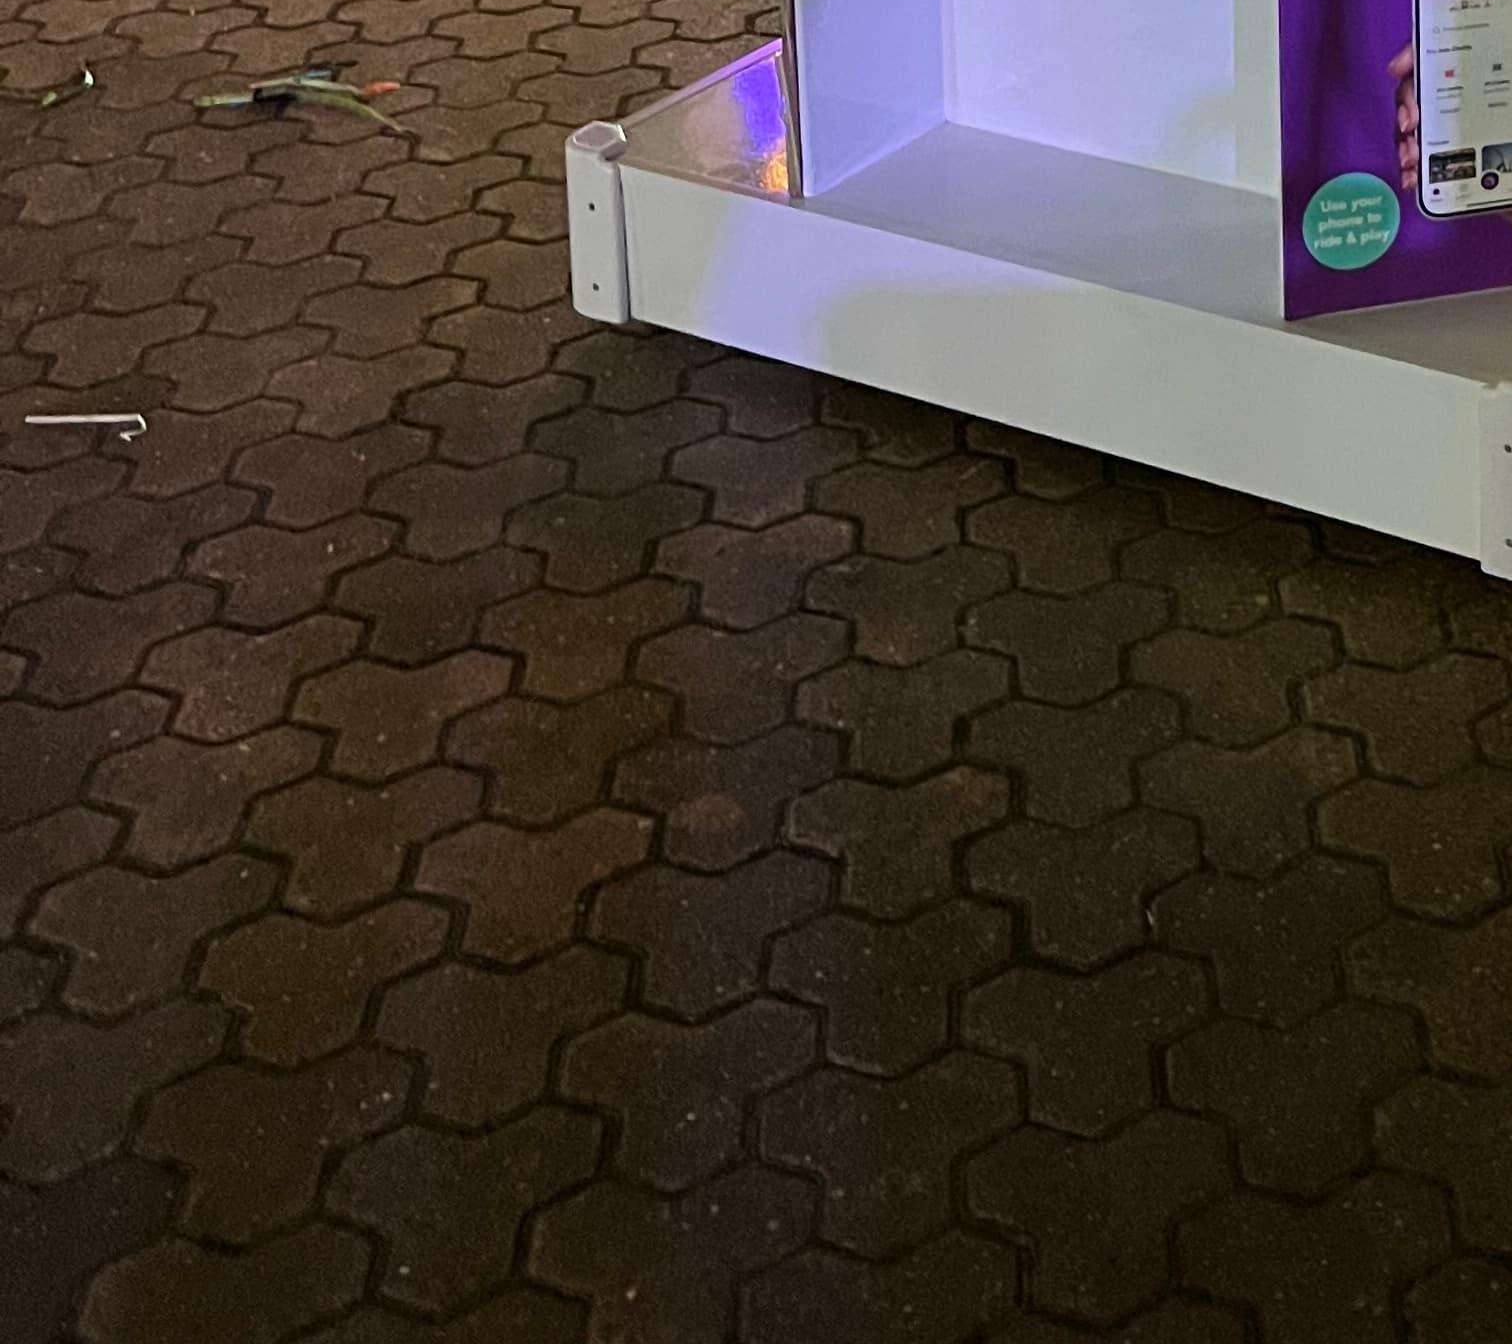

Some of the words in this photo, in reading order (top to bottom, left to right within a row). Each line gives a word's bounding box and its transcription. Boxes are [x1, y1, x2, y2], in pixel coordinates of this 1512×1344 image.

[1320, 200, 1347, 212] Use
[1351, 196, 1383, 212] your
[1318, 215, 1363, 233] phone
[1367, 212, 1382, 223] to
[1313, 234, 1342, 250] ride
[1360, 229, 1391, 246] play
